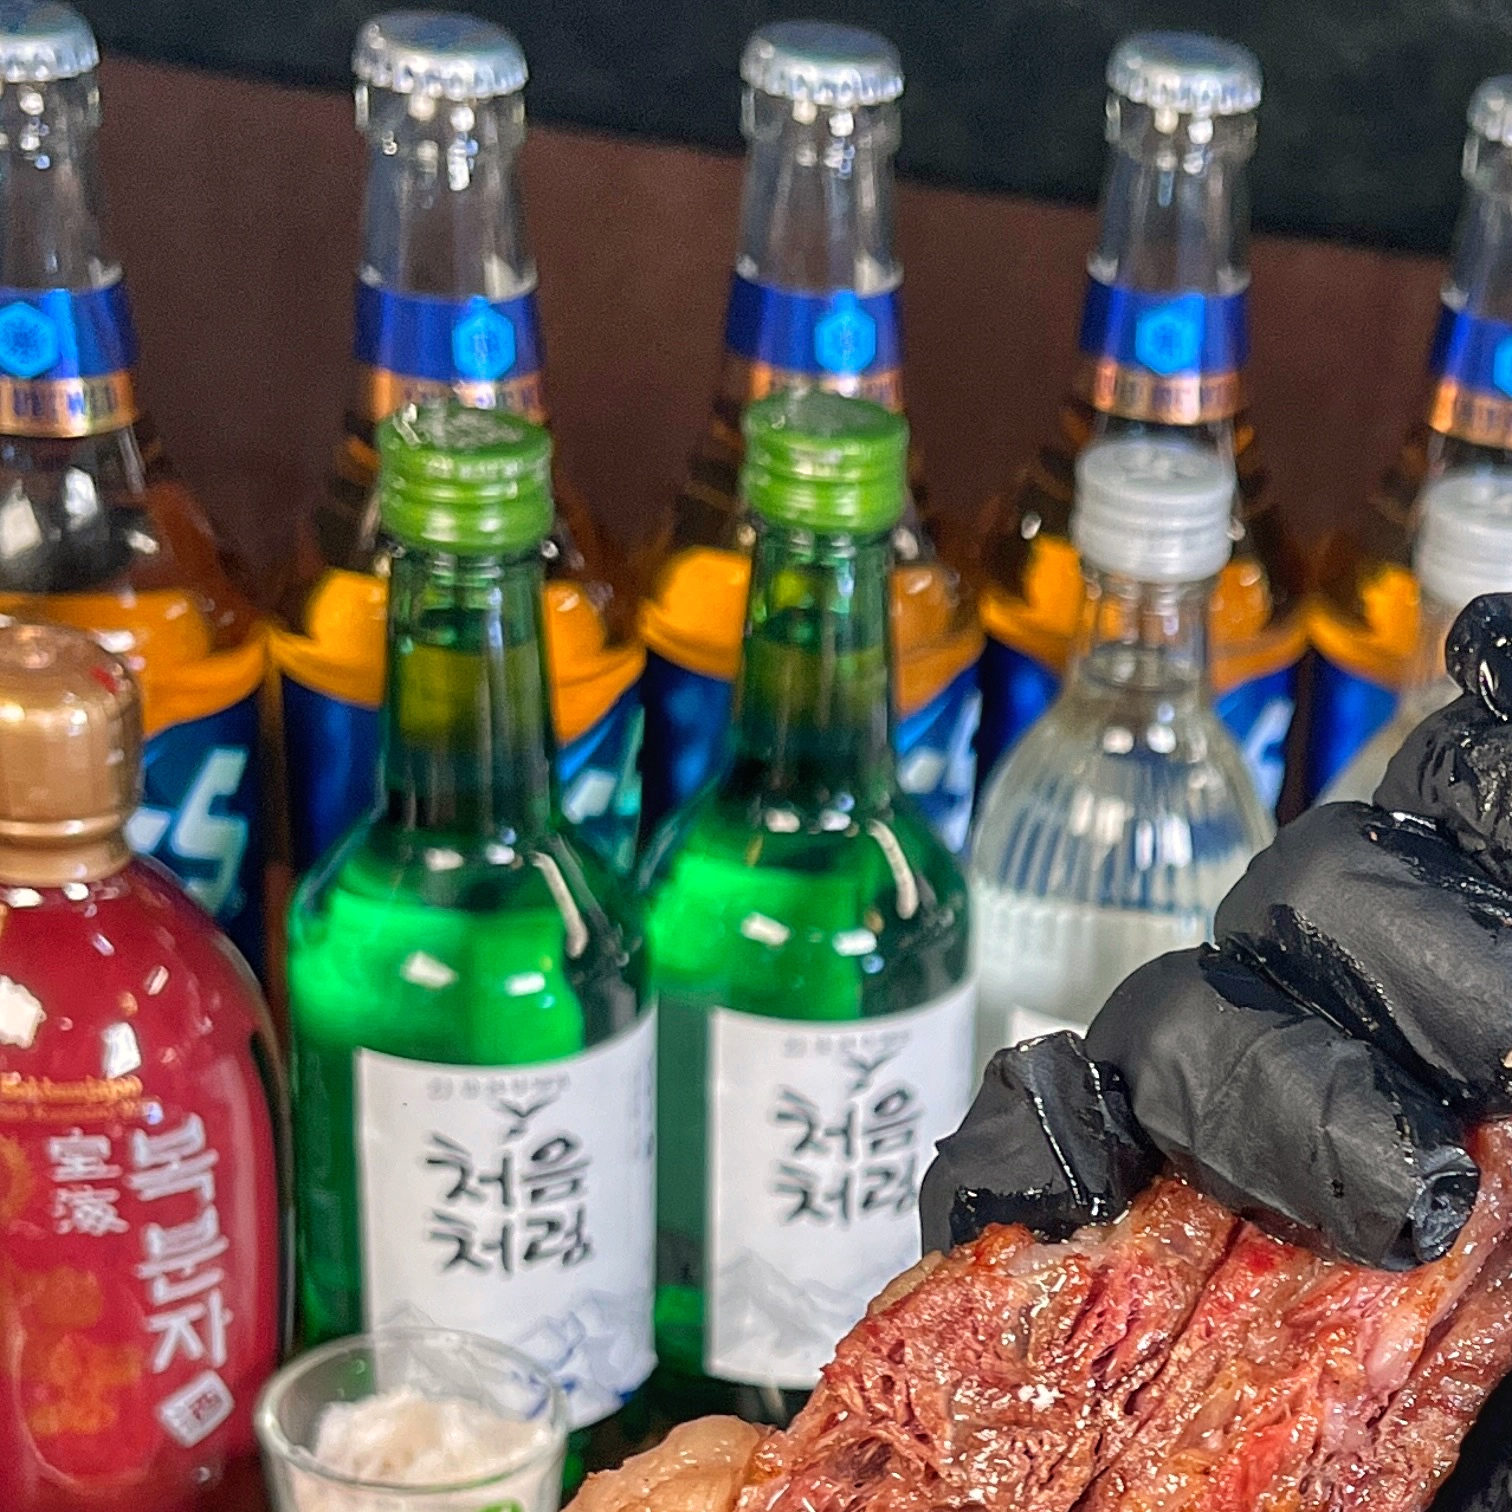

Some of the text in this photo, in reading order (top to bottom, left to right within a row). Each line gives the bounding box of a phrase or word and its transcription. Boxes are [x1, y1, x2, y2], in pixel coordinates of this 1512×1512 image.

[773, 1086, 924, 1157] 처음
[425, 1131, 590, 1206] 처음
[124, 1111, 234, 1372] 복분자
